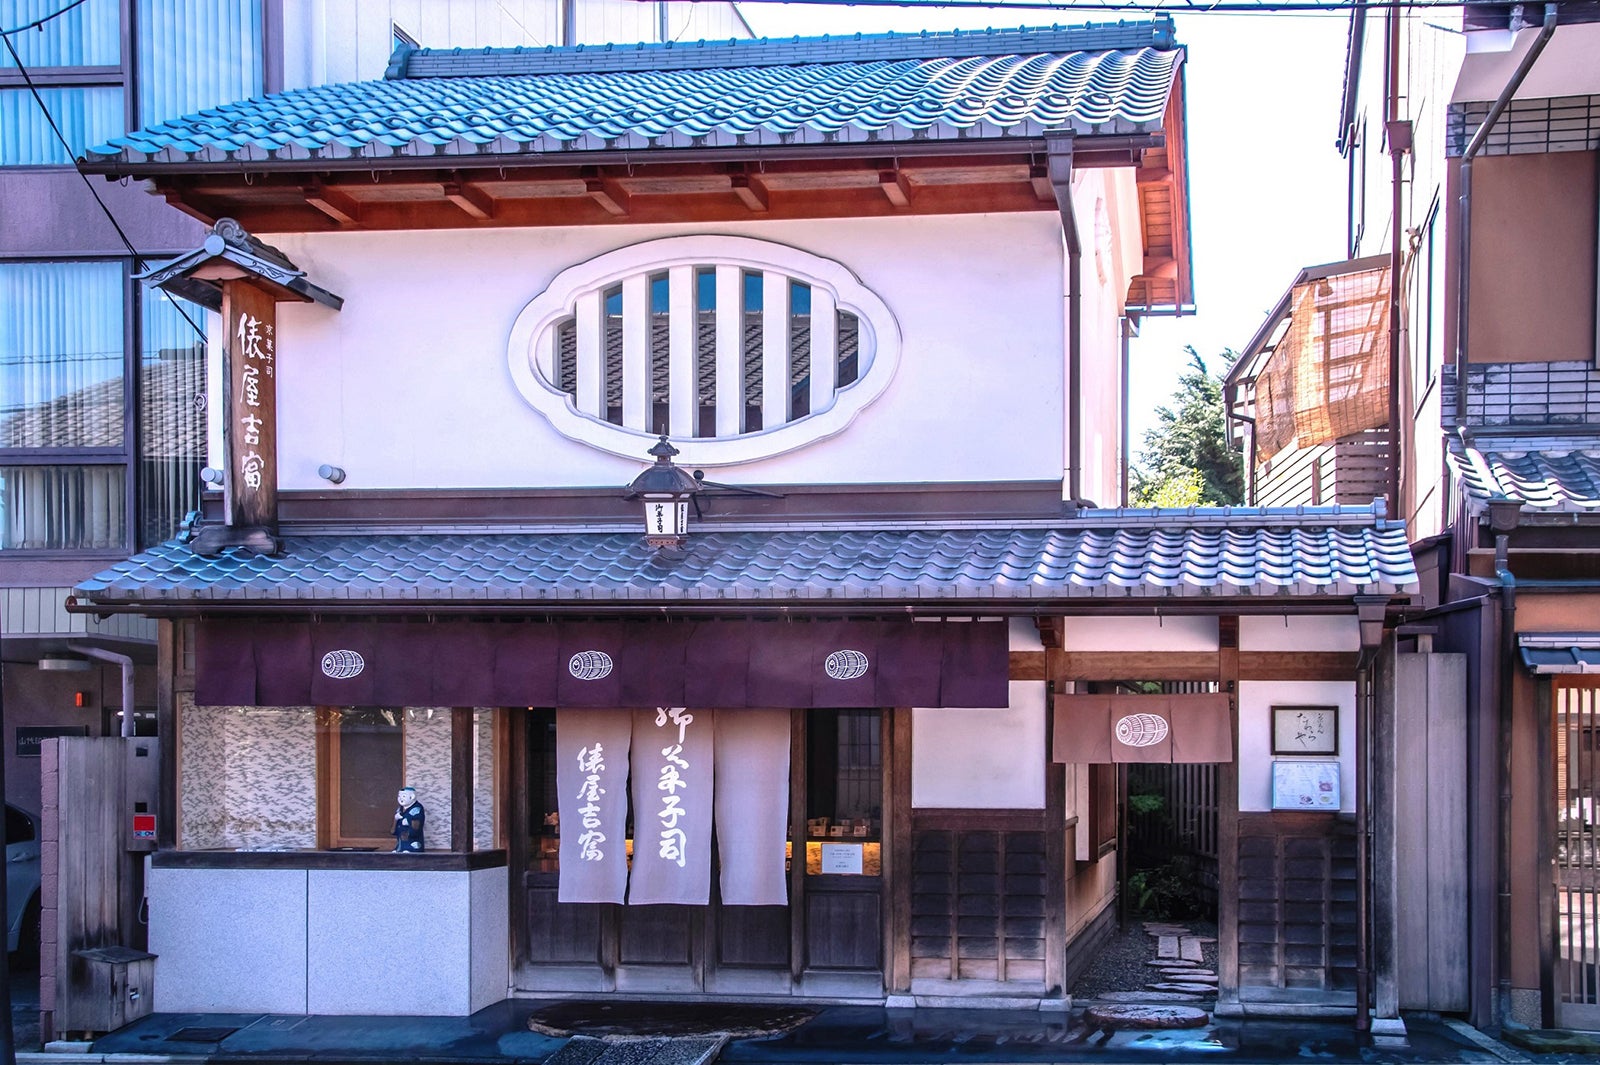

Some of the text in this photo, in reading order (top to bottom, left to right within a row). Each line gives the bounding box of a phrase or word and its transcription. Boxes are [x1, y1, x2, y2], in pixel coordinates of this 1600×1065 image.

[237, 312, 265, 491] 俵屋吉富
[265, 324, 273, 378] 京菓子司
[576, 743, 606, 861] 俵屋吉富
